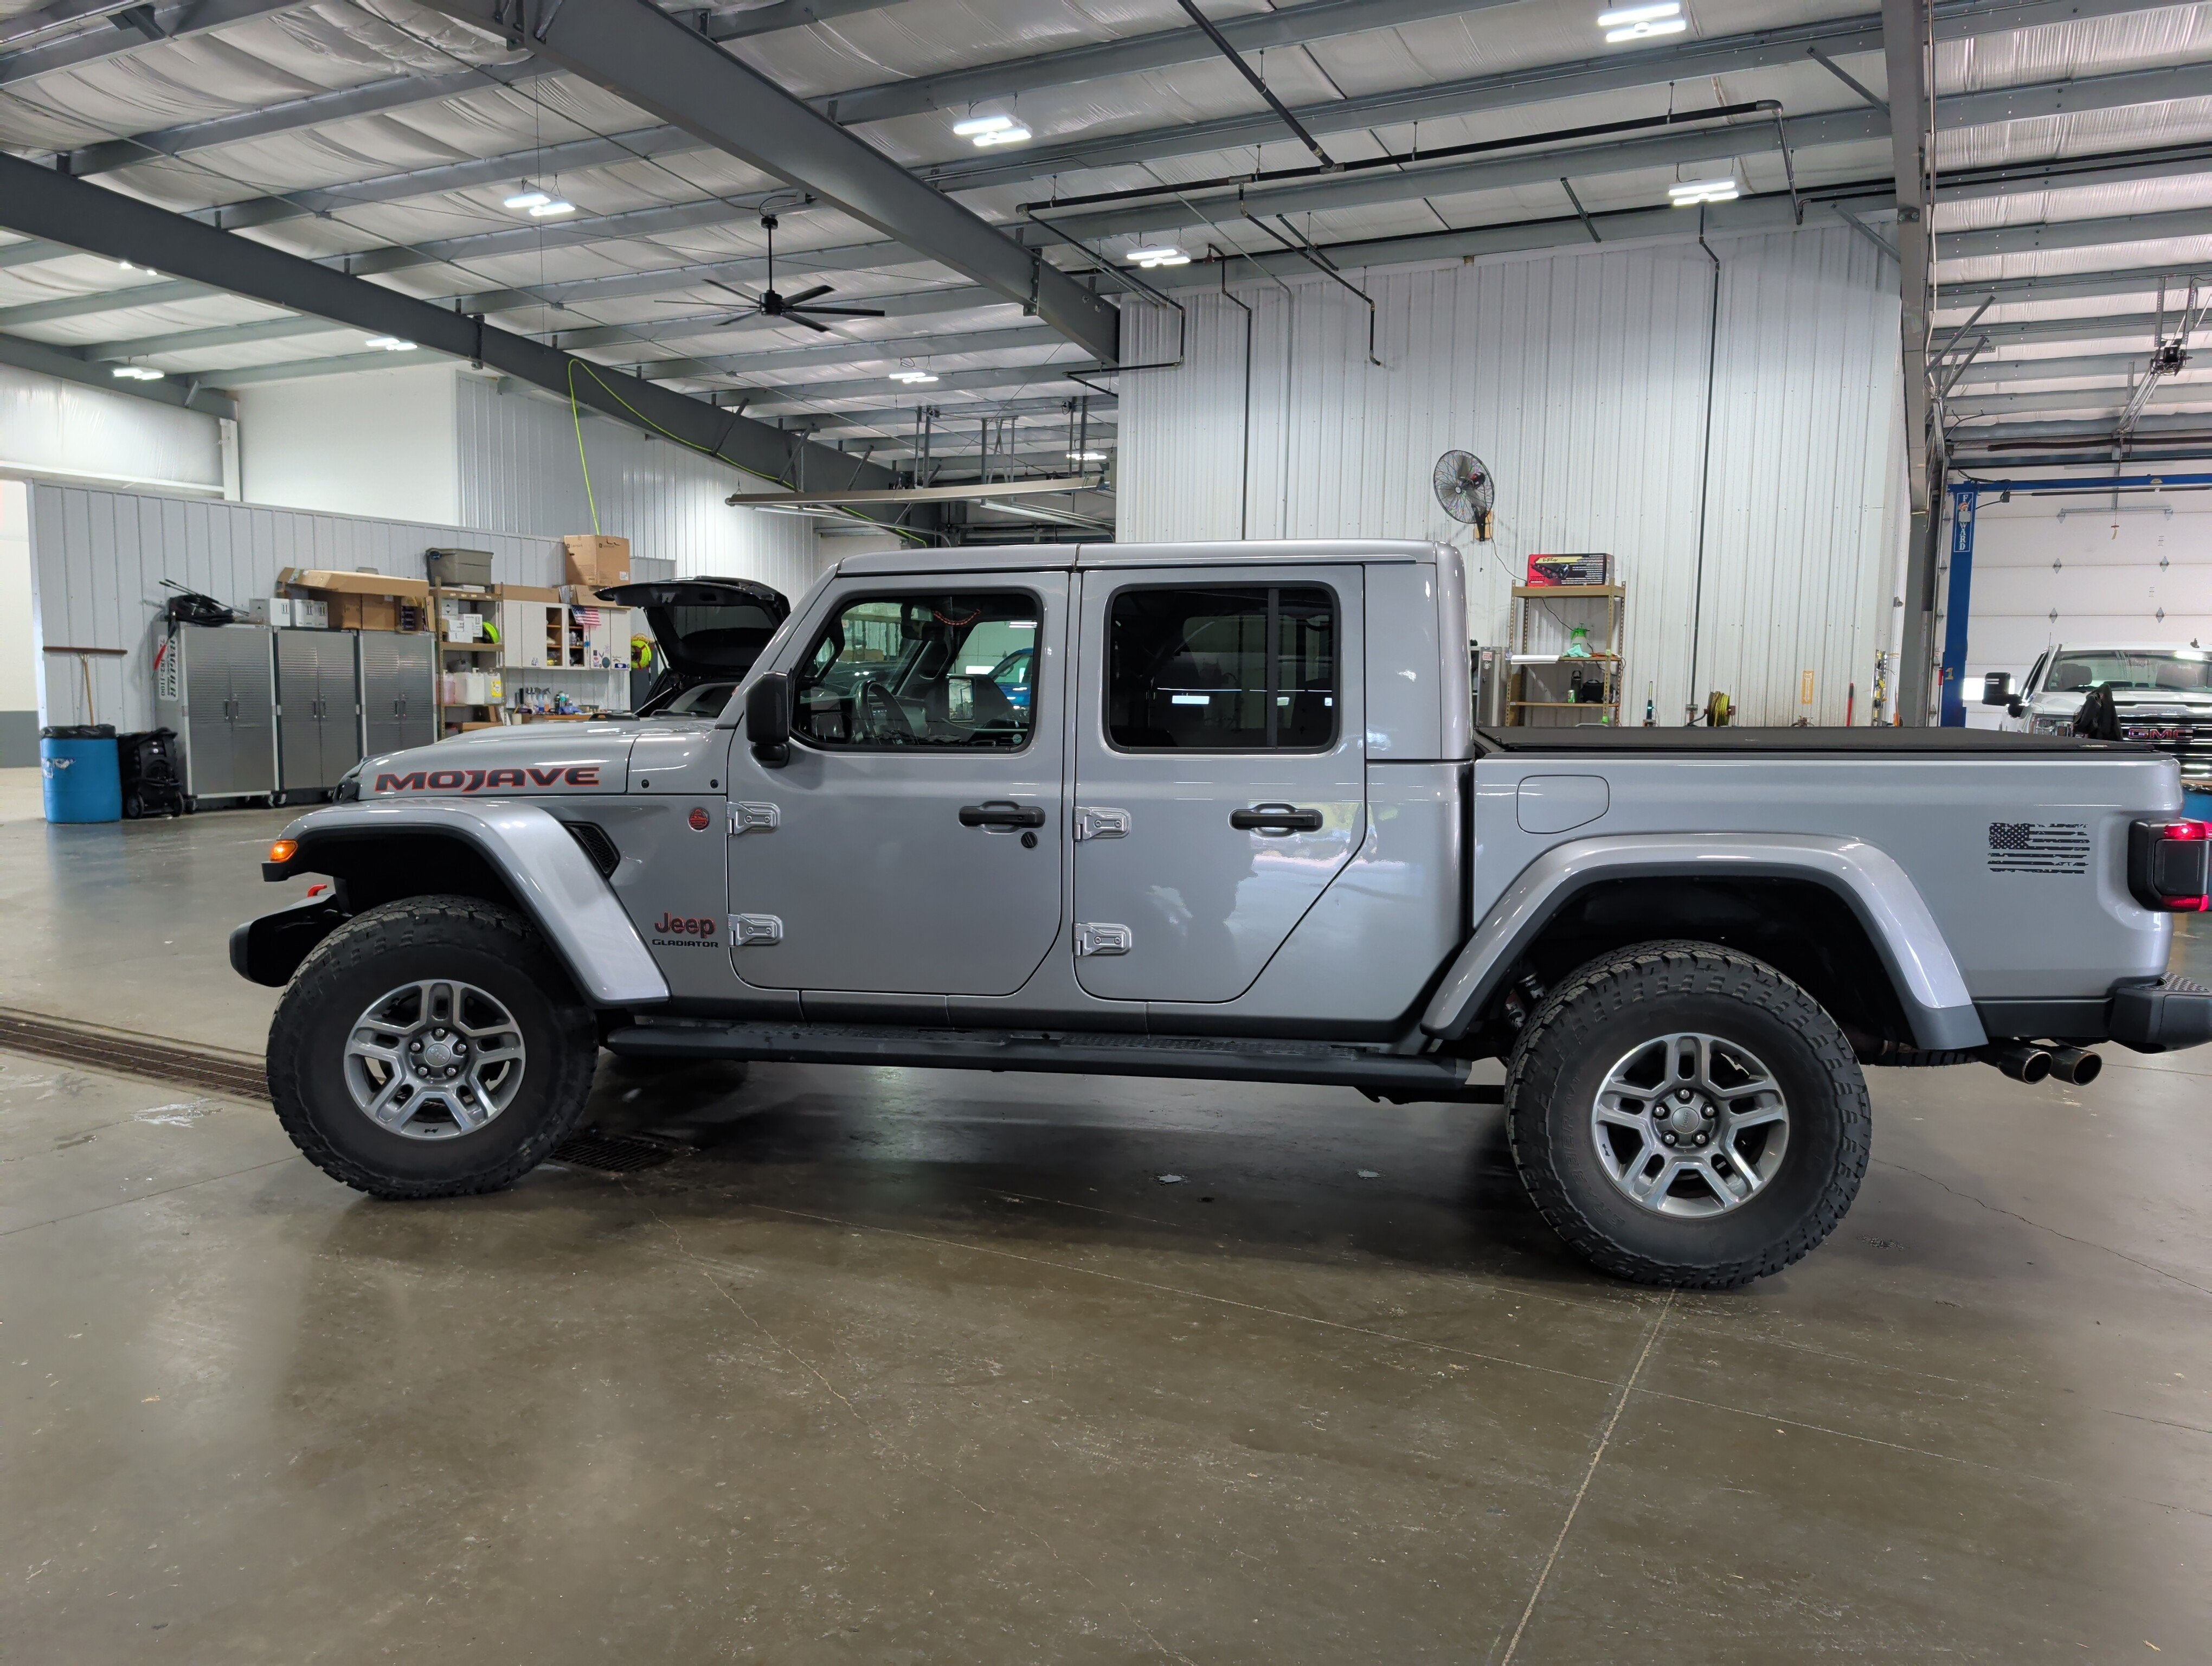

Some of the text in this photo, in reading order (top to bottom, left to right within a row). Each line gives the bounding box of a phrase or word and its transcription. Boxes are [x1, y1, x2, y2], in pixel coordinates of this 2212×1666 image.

[2129, 728, 2194, 740] GMC
[375, 767, 600, 792] MOJAVE
[654, 911, 716, 939] Jeep
[652, 939, 719, 948] GLADIATOR
[1679, 1110, 1690, 1128] Jeep
